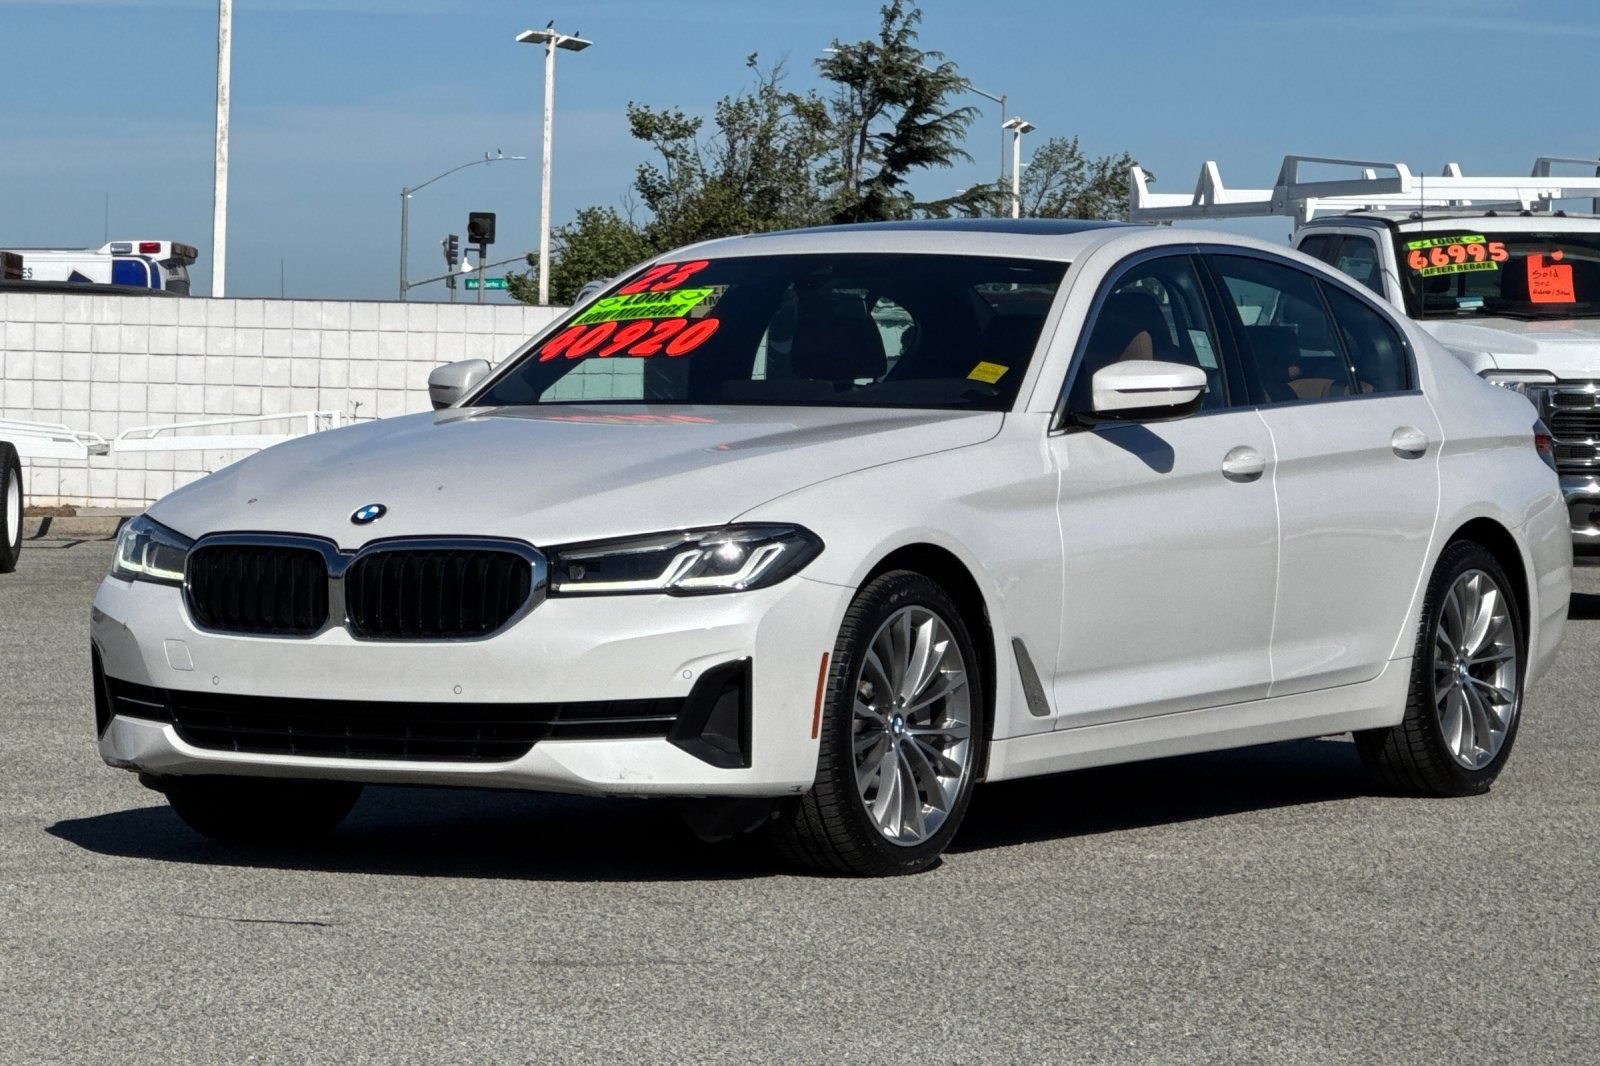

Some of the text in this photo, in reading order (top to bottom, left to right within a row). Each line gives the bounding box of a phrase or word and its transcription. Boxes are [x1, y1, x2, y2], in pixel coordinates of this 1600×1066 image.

[1430, 236, 1462, 246] LOOK
[1408, 242, 1509, 270] 66995
[619, 260, 708, 295] 23
[1424, 262, 1495, 275] AFTER REBATE
[624, 291, 677, 306] LOOK
[538, 318, 720, 363] 40920
